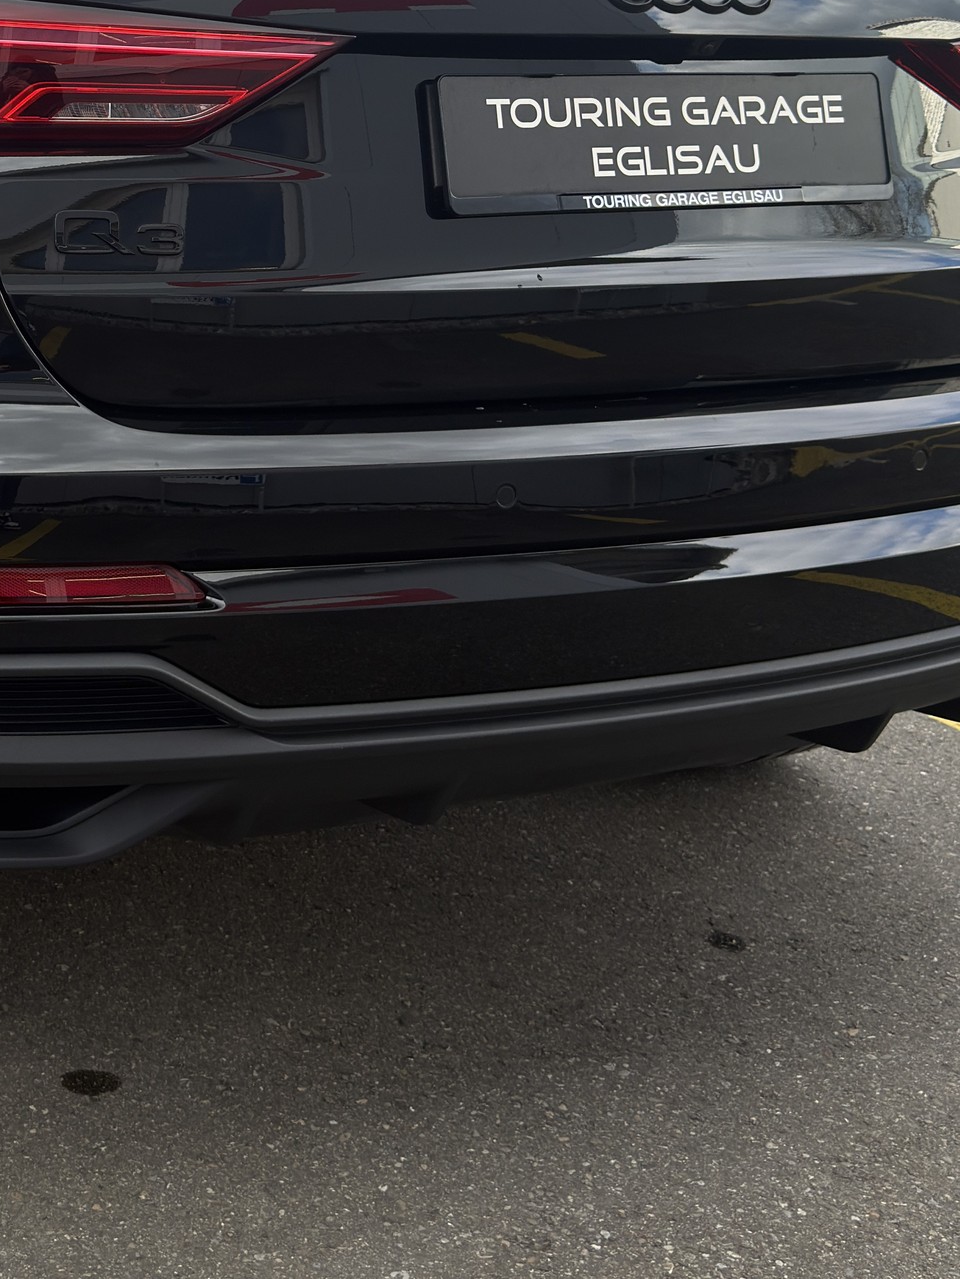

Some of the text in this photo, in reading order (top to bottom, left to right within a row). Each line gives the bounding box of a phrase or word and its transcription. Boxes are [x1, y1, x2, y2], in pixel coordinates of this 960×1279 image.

[486, 94, 845, 129] TOURING GARAGE
[591, 143, 760, 177] EGLISAU
[583, 189, 784, 209] TOURING GARAGE EGLISAU
[54, 209, 185, 256] Q3
